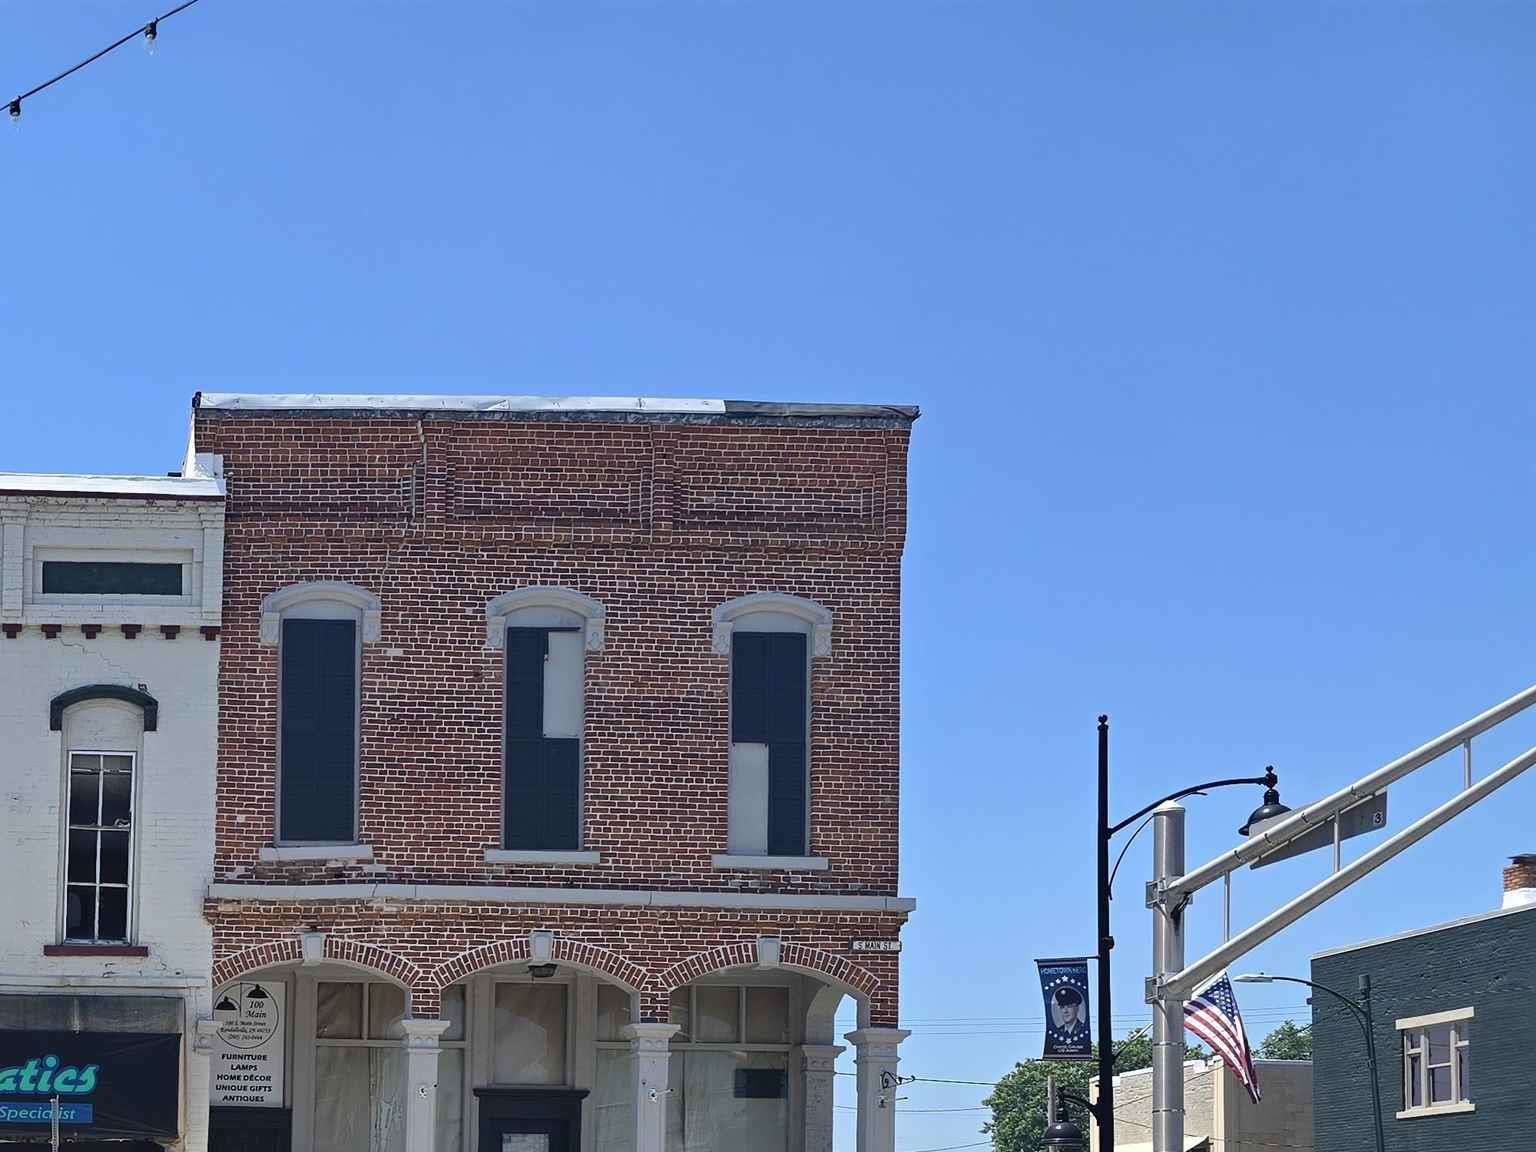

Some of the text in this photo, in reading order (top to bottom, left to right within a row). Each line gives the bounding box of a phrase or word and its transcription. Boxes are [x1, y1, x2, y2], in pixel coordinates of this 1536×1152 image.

[855, 941, 863, 950] S
[864, 940, 881, 950] MAIN
[249, 1001, 264, 1009] 100
[245, 1009, 267, 1018] Main
[222, 1053, 268, 1061] FURNITURE
[216, 1073, 242, 1081] HOME
[215, 1084, 248, 1092] UNIQUE
[222, 1094, 264, 1102] ANTIQUES
